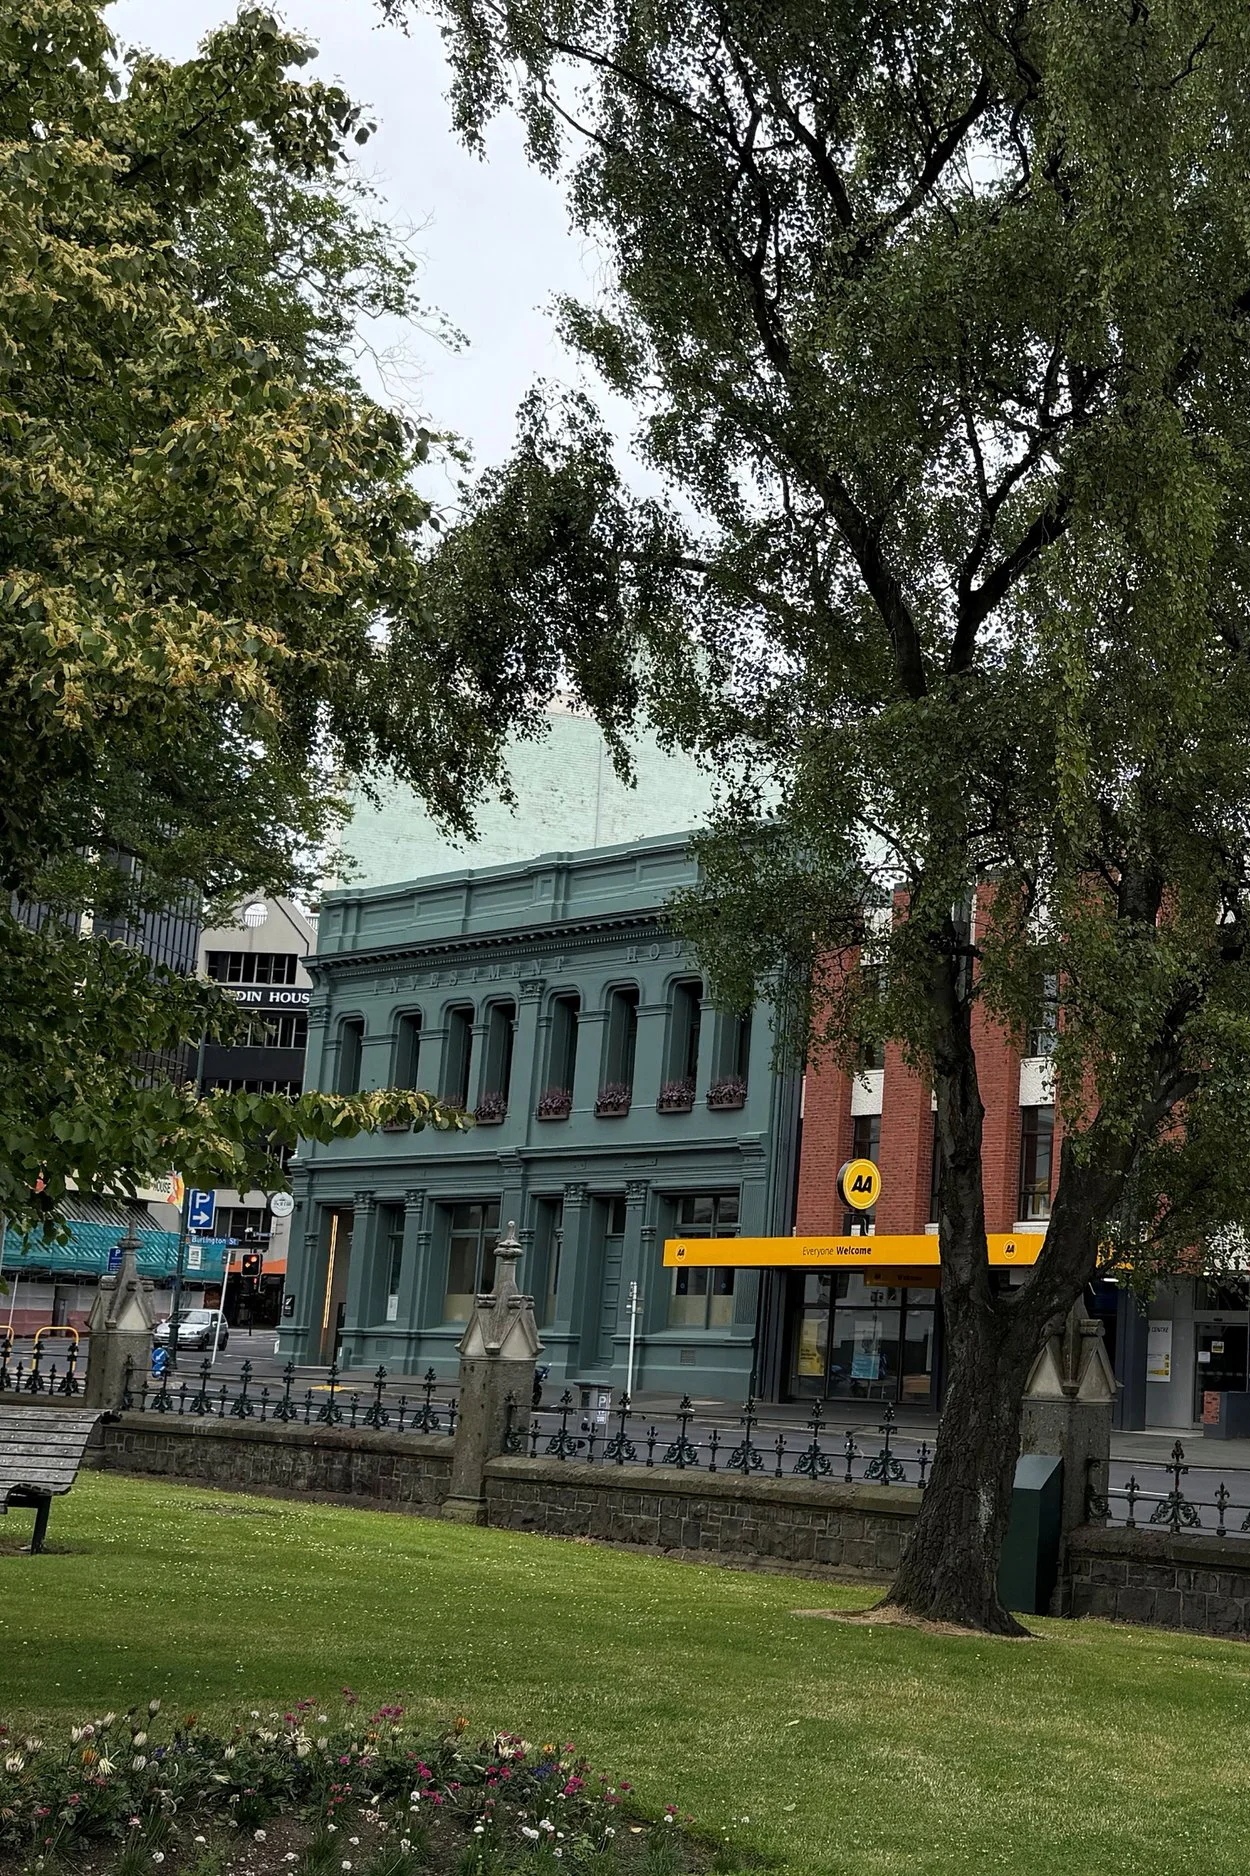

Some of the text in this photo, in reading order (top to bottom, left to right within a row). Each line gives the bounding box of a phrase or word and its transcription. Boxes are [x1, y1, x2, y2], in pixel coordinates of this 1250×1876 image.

[372, 940, 683, 993] INVESTMENT HOU
[232, 990, 313, 1004] DIN HOUS
[850, 1175, 873, 1194] AA
[195, 1192, 211, 1209] P
[191, 1235, 227, 1246] Burlington
[802, 1245, 872, 1258] Everyone Welcome
